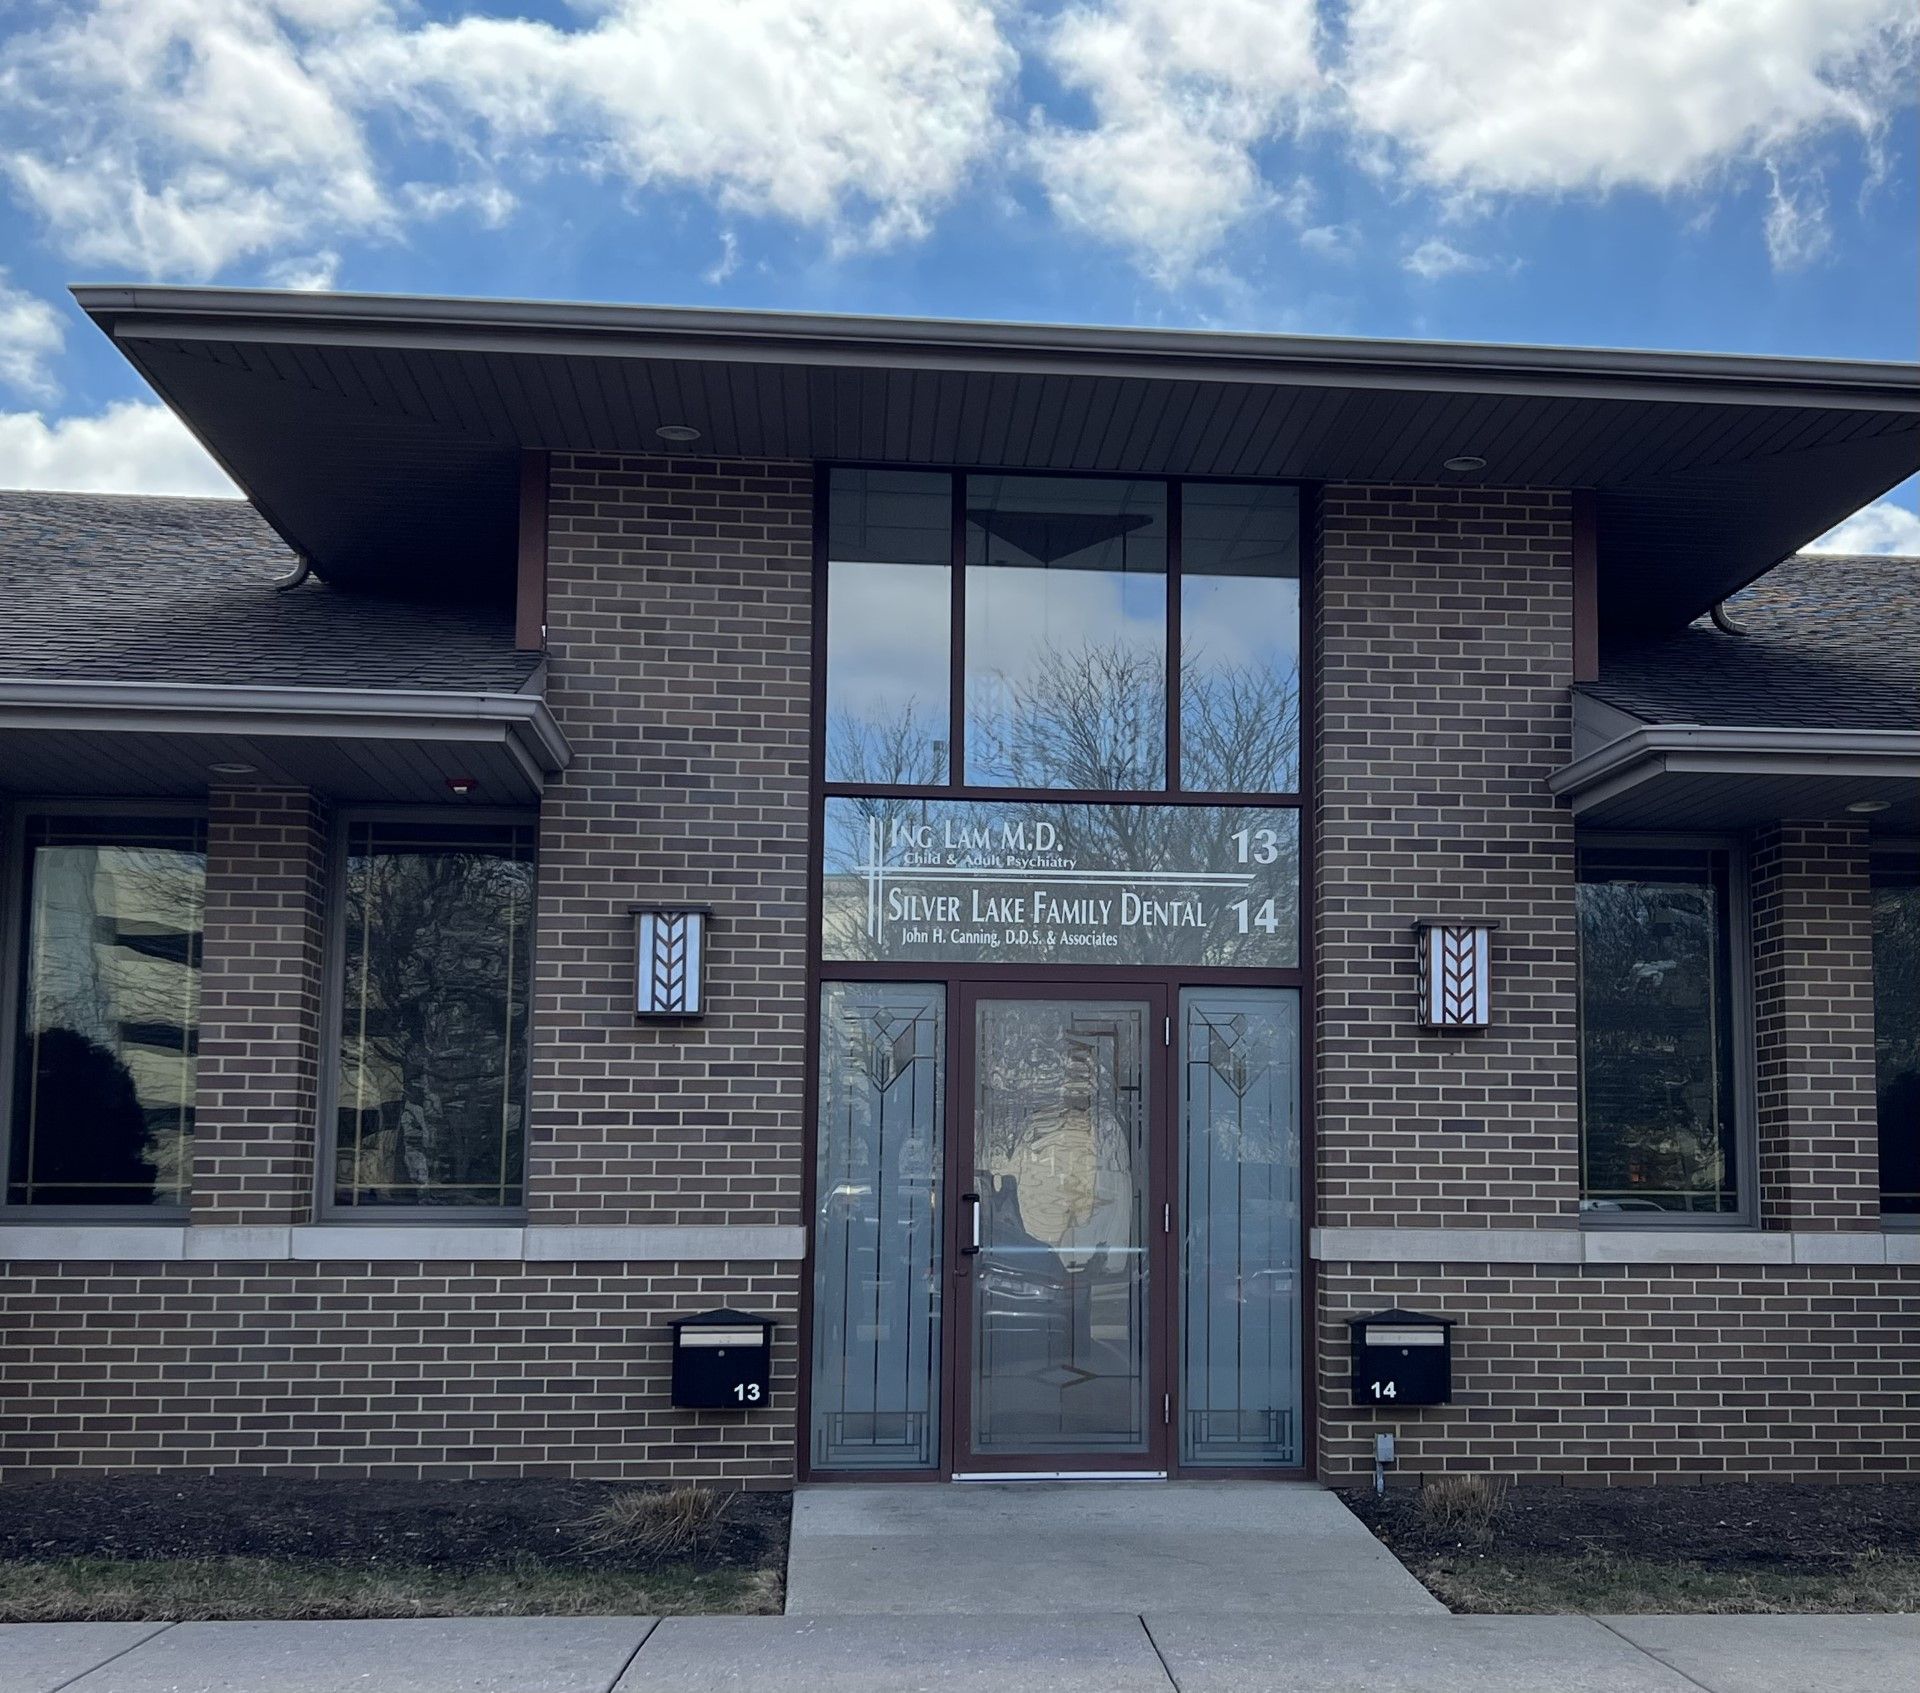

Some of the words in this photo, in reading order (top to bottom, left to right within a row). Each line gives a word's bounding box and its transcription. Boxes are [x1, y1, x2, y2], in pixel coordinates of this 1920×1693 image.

[891, 818, 932, 849] ING
[944, 819, 991, 850] LAM
[1001, 821, 1064, 852] M.D.
[1231, 828, 1278, 864] 13
[904, 852, 941, 866] Child
[946, 853, 957, 866] &
[965, 853, 1000, 867] Adult
[1006, 855, 1077, 870] Psychiatry
[888, 887, 961, 922] SILVER
[972, 889, 1025, 923] LAKE
[1033, 890, 1112, 925] FAMILY
[1121, 892, 1207, 927] DENTAL
[1231, 899, 1279, 934] 14
[901, 927, 928, 945] John
[933, 929, 946, 944] H.
[951, 928, 1000, 947] Canning,
[1006, 929, 1042, 945] D.D.S.
[1046, 930, 1056, 945] &
[1060, 930, 1118, 946] Associates
[733, 1383, 761, 1401] 13
[1371, 1381, 1397, 1399] 14
